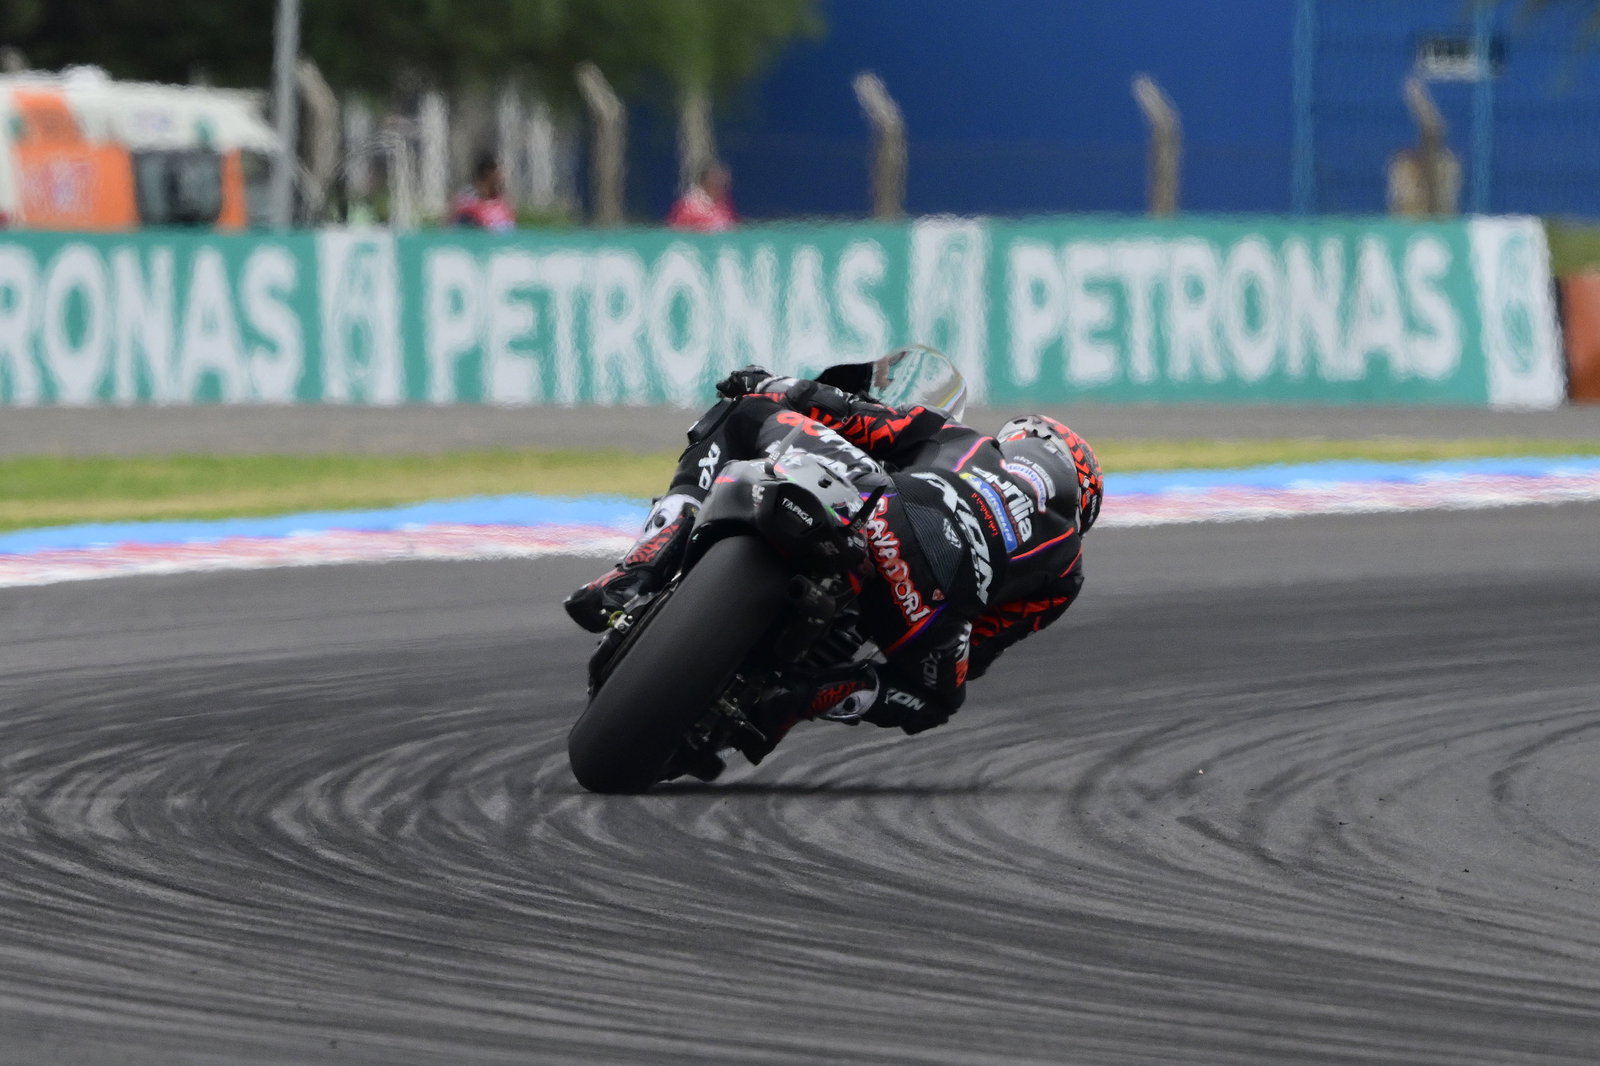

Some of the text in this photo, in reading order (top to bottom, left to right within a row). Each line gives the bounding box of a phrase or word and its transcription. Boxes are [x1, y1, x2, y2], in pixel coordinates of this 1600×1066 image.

[422, 241, 893, 407] PETRONAS
[1006, 235, 1463, 384] PETRONAS
[782, 497, 814, 527] TARGA
